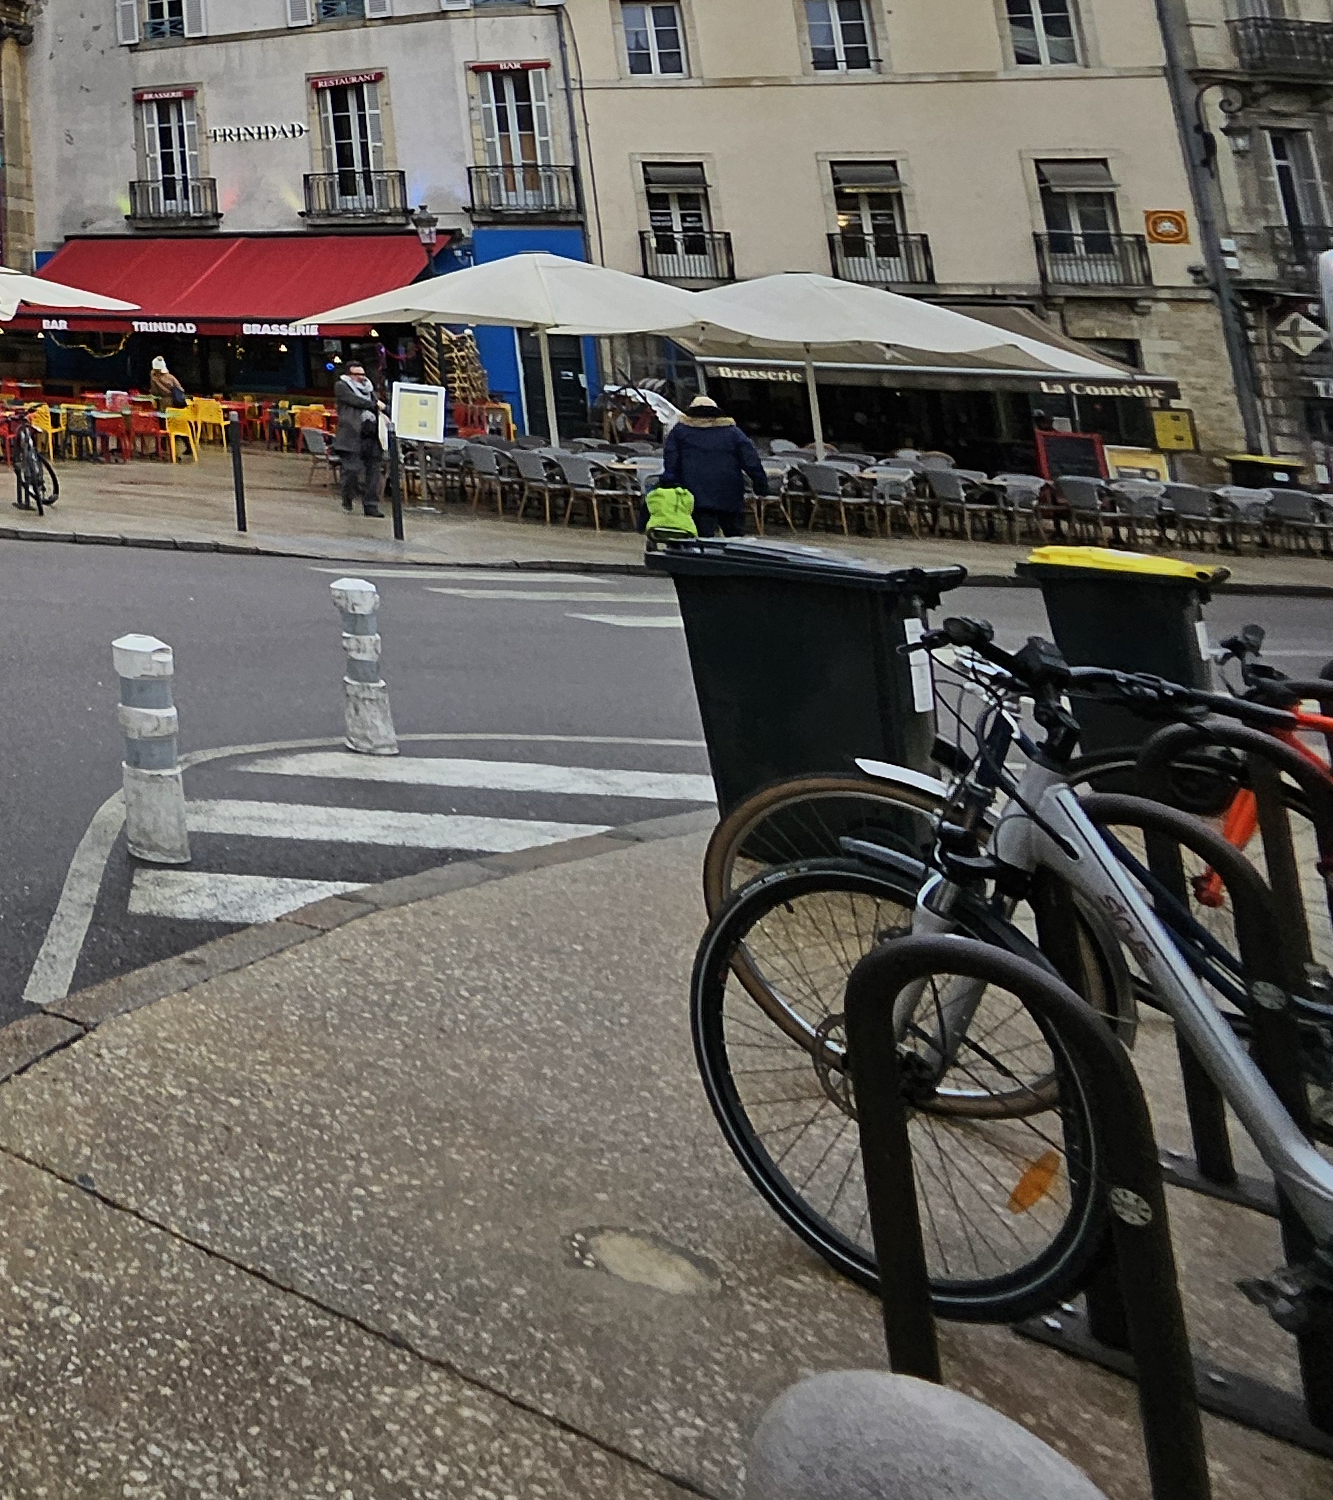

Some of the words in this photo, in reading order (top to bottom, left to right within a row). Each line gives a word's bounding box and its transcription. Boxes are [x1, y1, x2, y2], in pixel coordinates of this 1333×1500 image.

[499, 62, 522, 70] BAR
[317, 72, 376, 88] RESTAURANT
[142, 91, 184, 100] BRASSERIE
[209, 123, 305, 143] TRINIDAD
[42, 319, 68, 330] BAR
[132, 321, 197, 334] TRINIDAD
[242, 323, 319, 336] BRASSERIE
[717, 366, 803, 382] Brasserie
[1039, 381, 1066, 394] La
[1069, 382, 1166, 398] Comédie
